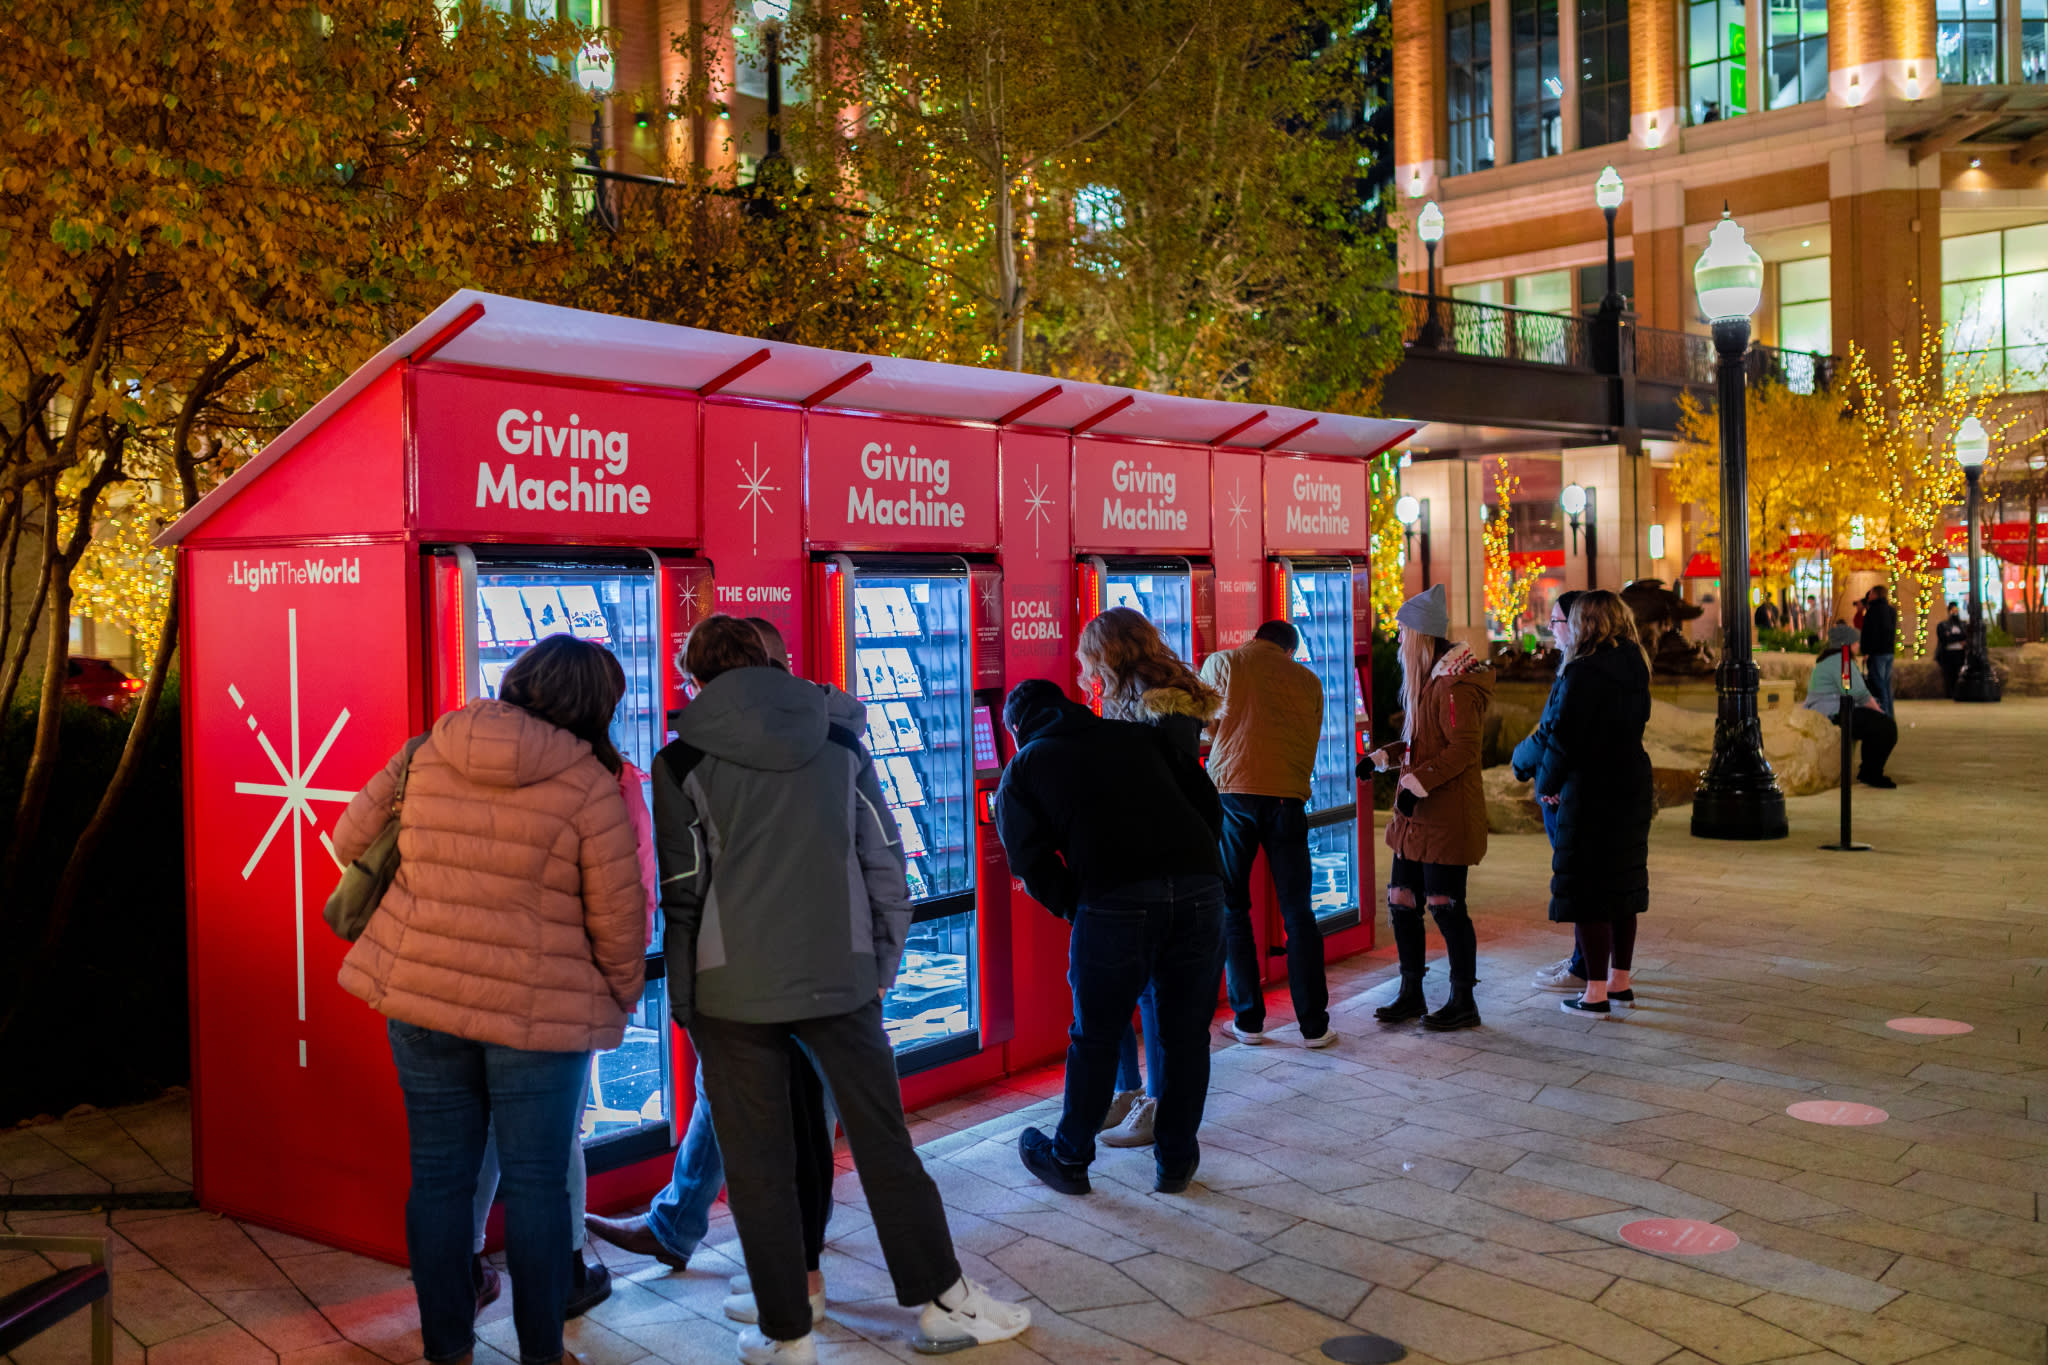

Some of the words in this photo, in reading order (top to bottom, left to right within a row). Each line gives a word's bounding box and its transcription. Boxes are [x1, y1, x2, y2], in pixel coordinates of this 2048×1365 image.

[496, 408, 629, 476] Giving
[861, 441, 950, 495] Giving
[1111, 460, 1177, 503] Giving
[475, 462, 651, 515] Machine
[1293, 473, 1341, 509] Giving
[847, 486, 965, 528] Machine
[1102, 498, 1188, 531] Machine
[1286, 505, 1350, 535] Machine
[717, 586, 743, 602] THE
[746, 586, 792, 602] GIVING
[1219, 581, 1233, 593] THE
[1233, 581, 1257, 593] GIVING
[1011, 601, 1053, 618] LOCAL
[1011, 621, 1063, 640] GLOBAL
